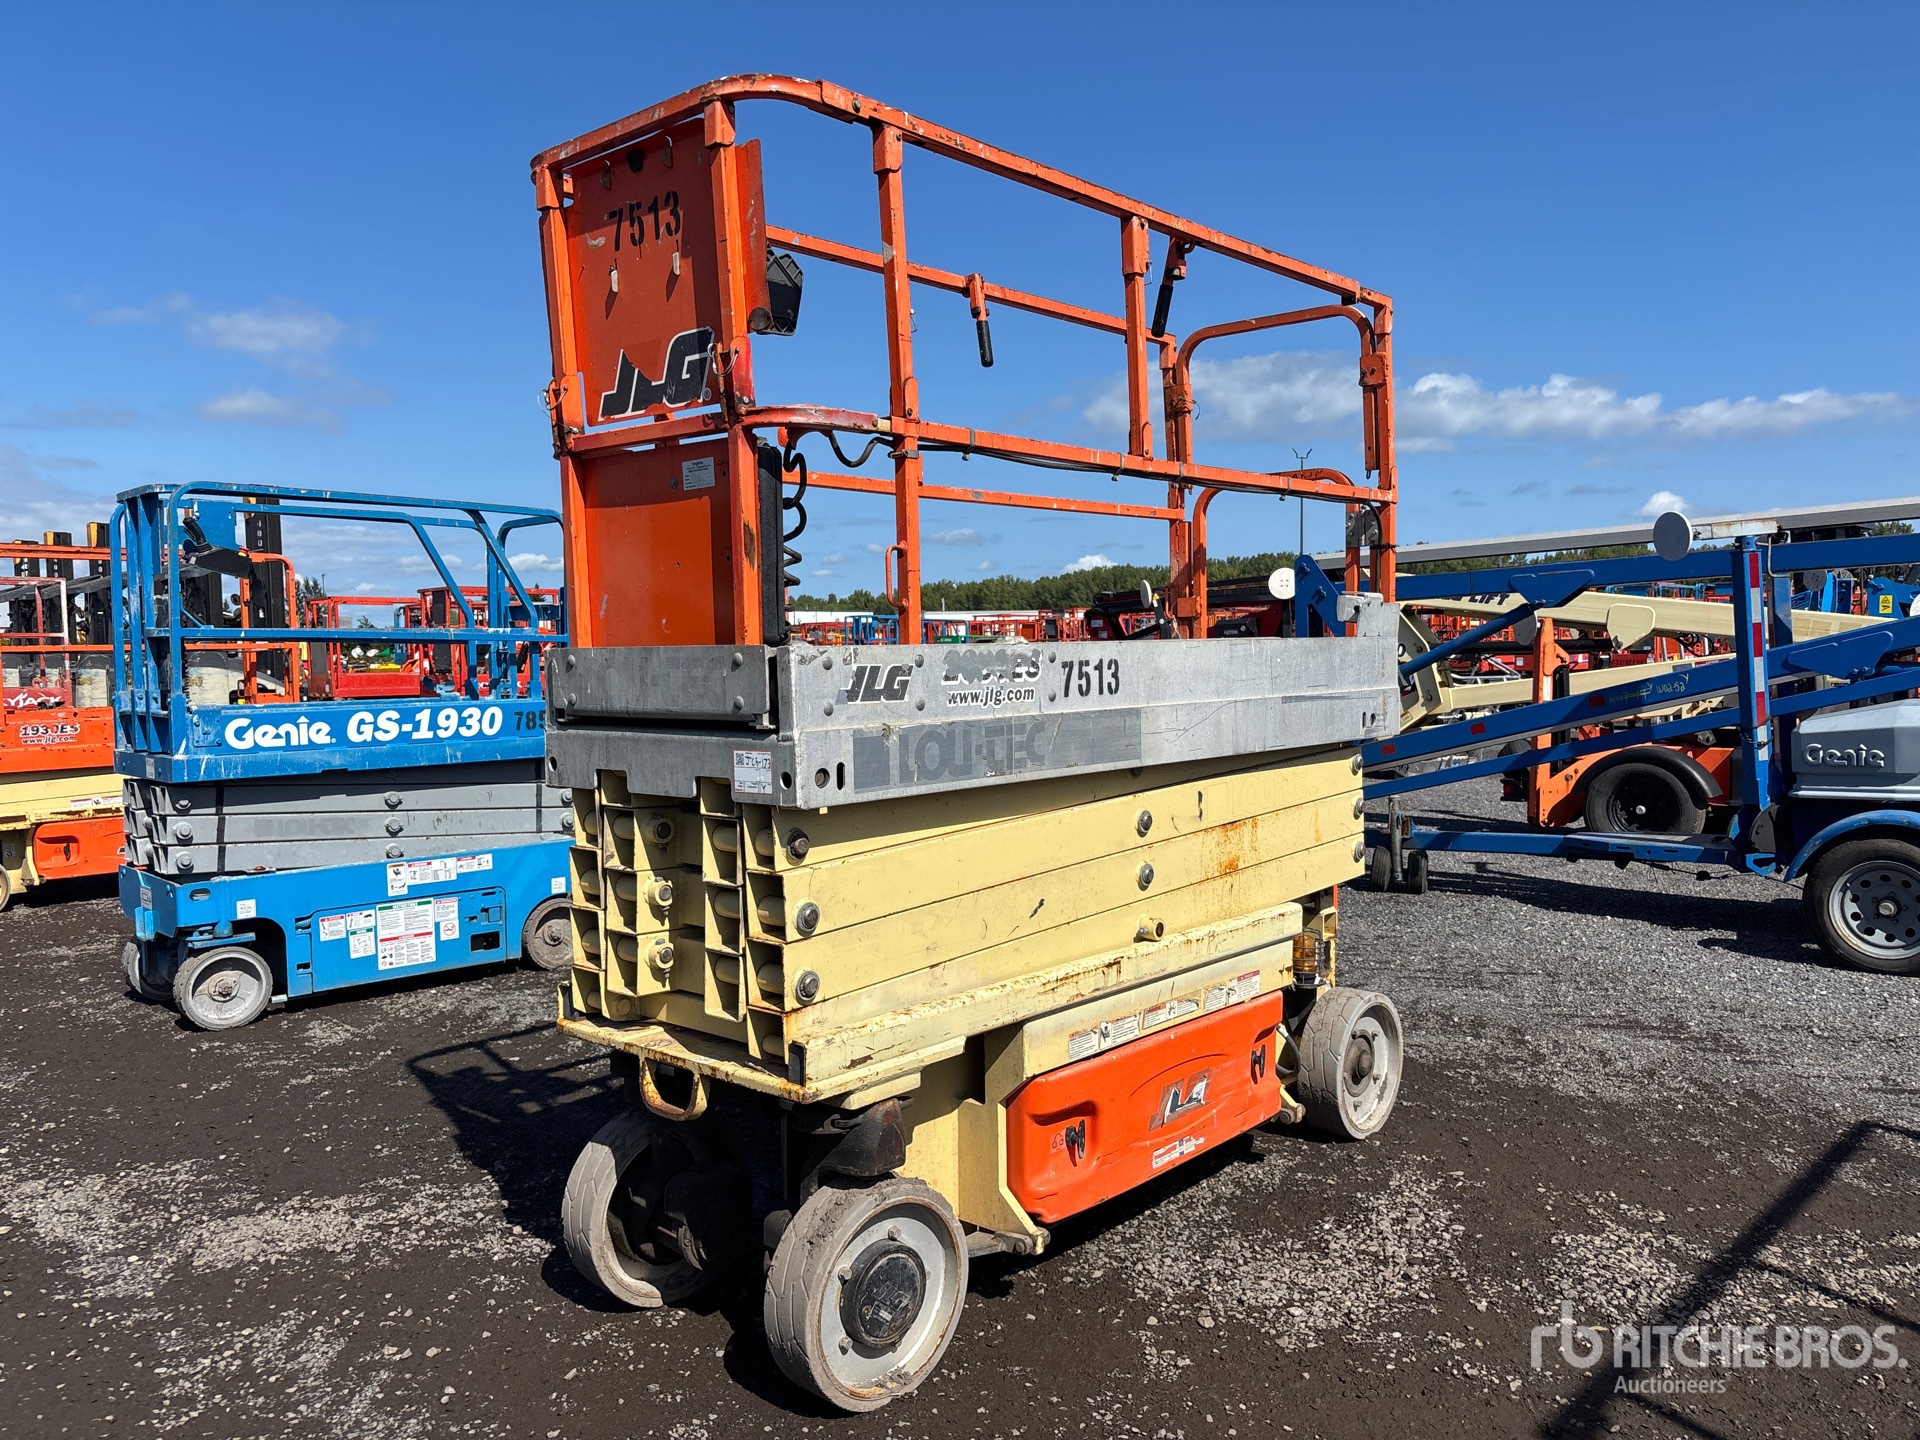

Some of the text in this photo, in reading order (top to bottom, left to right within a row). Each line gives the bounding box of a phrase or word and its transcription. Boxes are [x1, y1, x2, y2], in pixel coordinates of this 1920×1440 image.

[608, 190, 681, 252] 7513
[1468, 593, 1510, 606] LIFT
[835, 664, 915, 705] JLG
[1061, 658, 1120, 698] 7513
[948, 687, 1035, 707] www.jlg.com
[22, 735, 77, 744] www.jlg.com
[224, 706, 503, 750] Genie GS-1930
[1803, 743, 1885, 768] Genie
